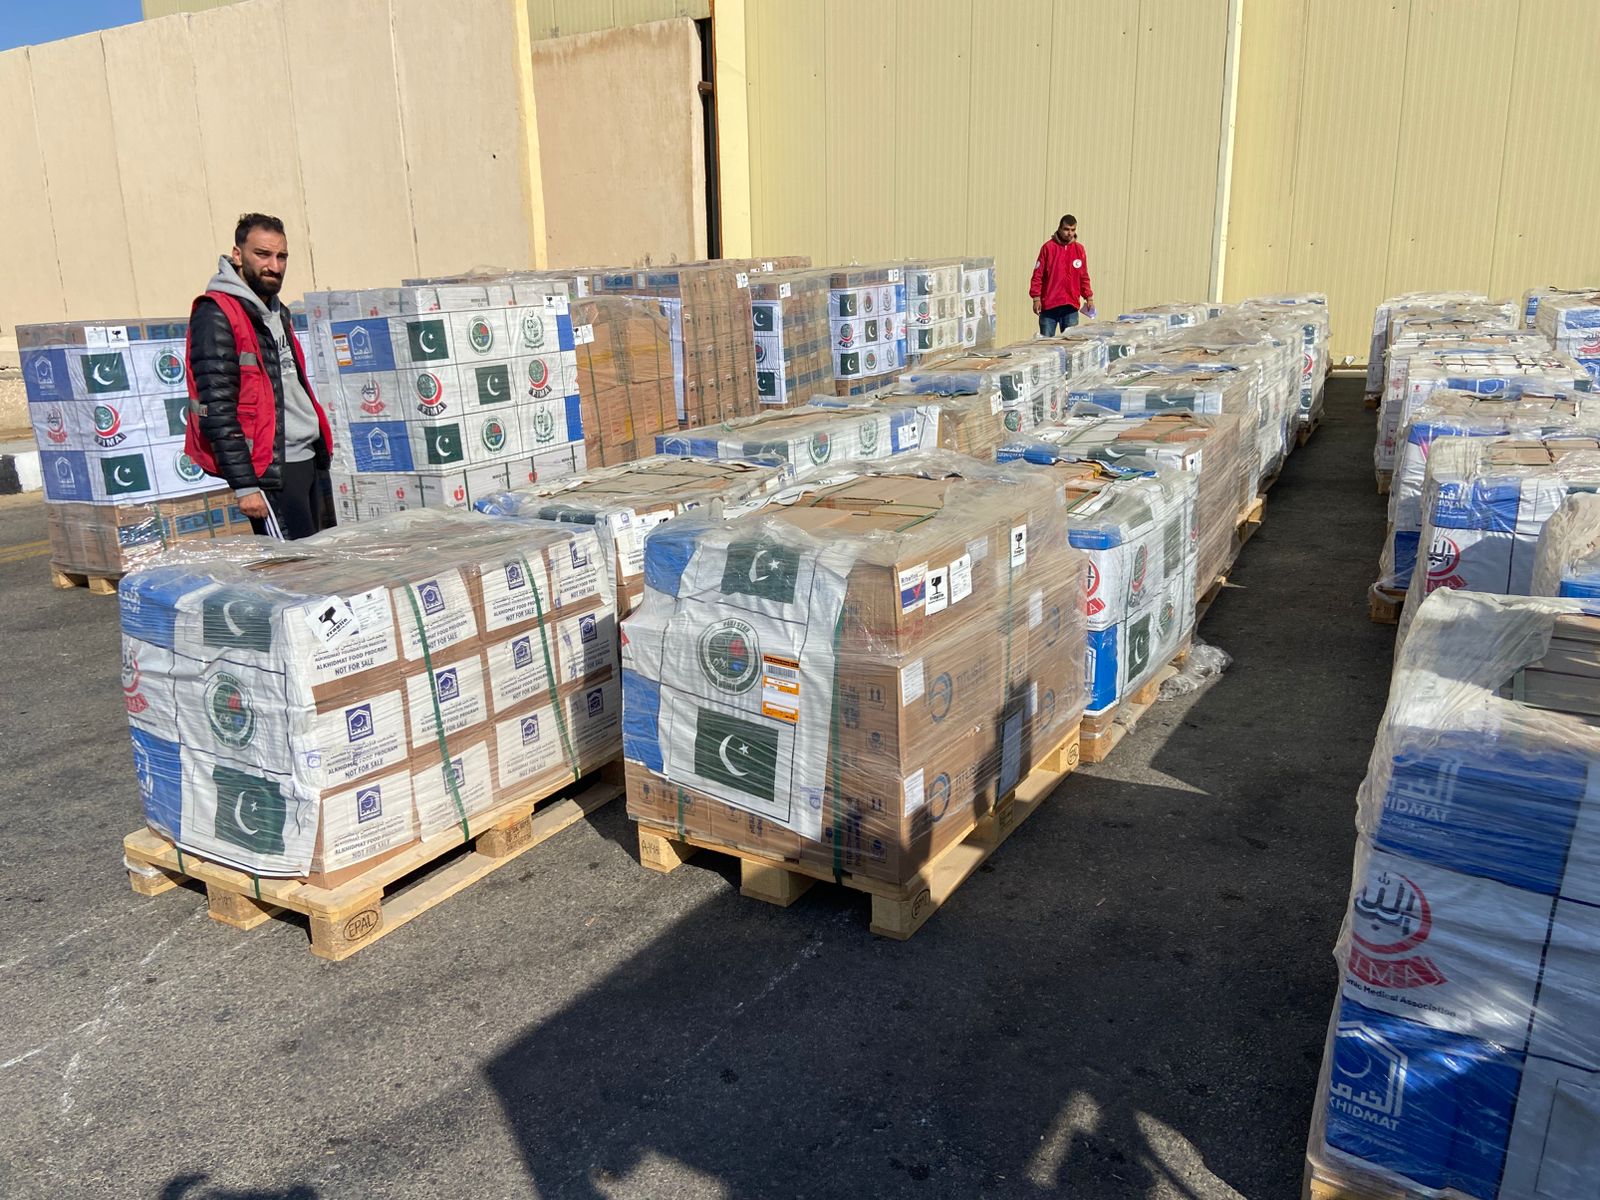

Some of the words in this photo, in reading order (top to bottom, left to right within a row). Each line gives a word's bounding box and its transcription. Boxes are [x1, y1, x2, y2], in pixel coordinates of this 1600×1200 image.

[525, 607, 534, 615] SALE
[723, 620, 750, 633] PAKISTAN
[437, 637, 447, 645] FOR
[447, 632, 458, 641] SALE
[316, 657, 348, 670] ALKHIDMAT
[348, 653, 364, 661] FOOD
[364, 645, 388, 657] PROGRAM
[335, 666, 347, 675] NOT
[348, 662, 360, 671] FOR
[361, 657, 374, 668] SALE
[531, 683, 540, 692] SALE
[446, 724, 456, 733] FOR
[457, 718, 467, 728] SALE
[447, 715, 459, 723] FOOD
[374, 745, 398, 757] PROGRAM
[345, 768, 357, 778] NOT
[358, 764, 370, 773] FOR
[370, 758, 384, 768] SALE
[335, 841, 366, 855] ALKHIDMAT
[367, 836, 382, 845] FOOD
[352, 849, 364, 859] NOT
[366, 845, 377, 853] FOR
[349, 914, 374, 938] EPAL
[1354, 956, 1426, 987] IMA
[1363, 985, 1399, 1002] Medical
[1400, 996, 1457, 1018] Association
